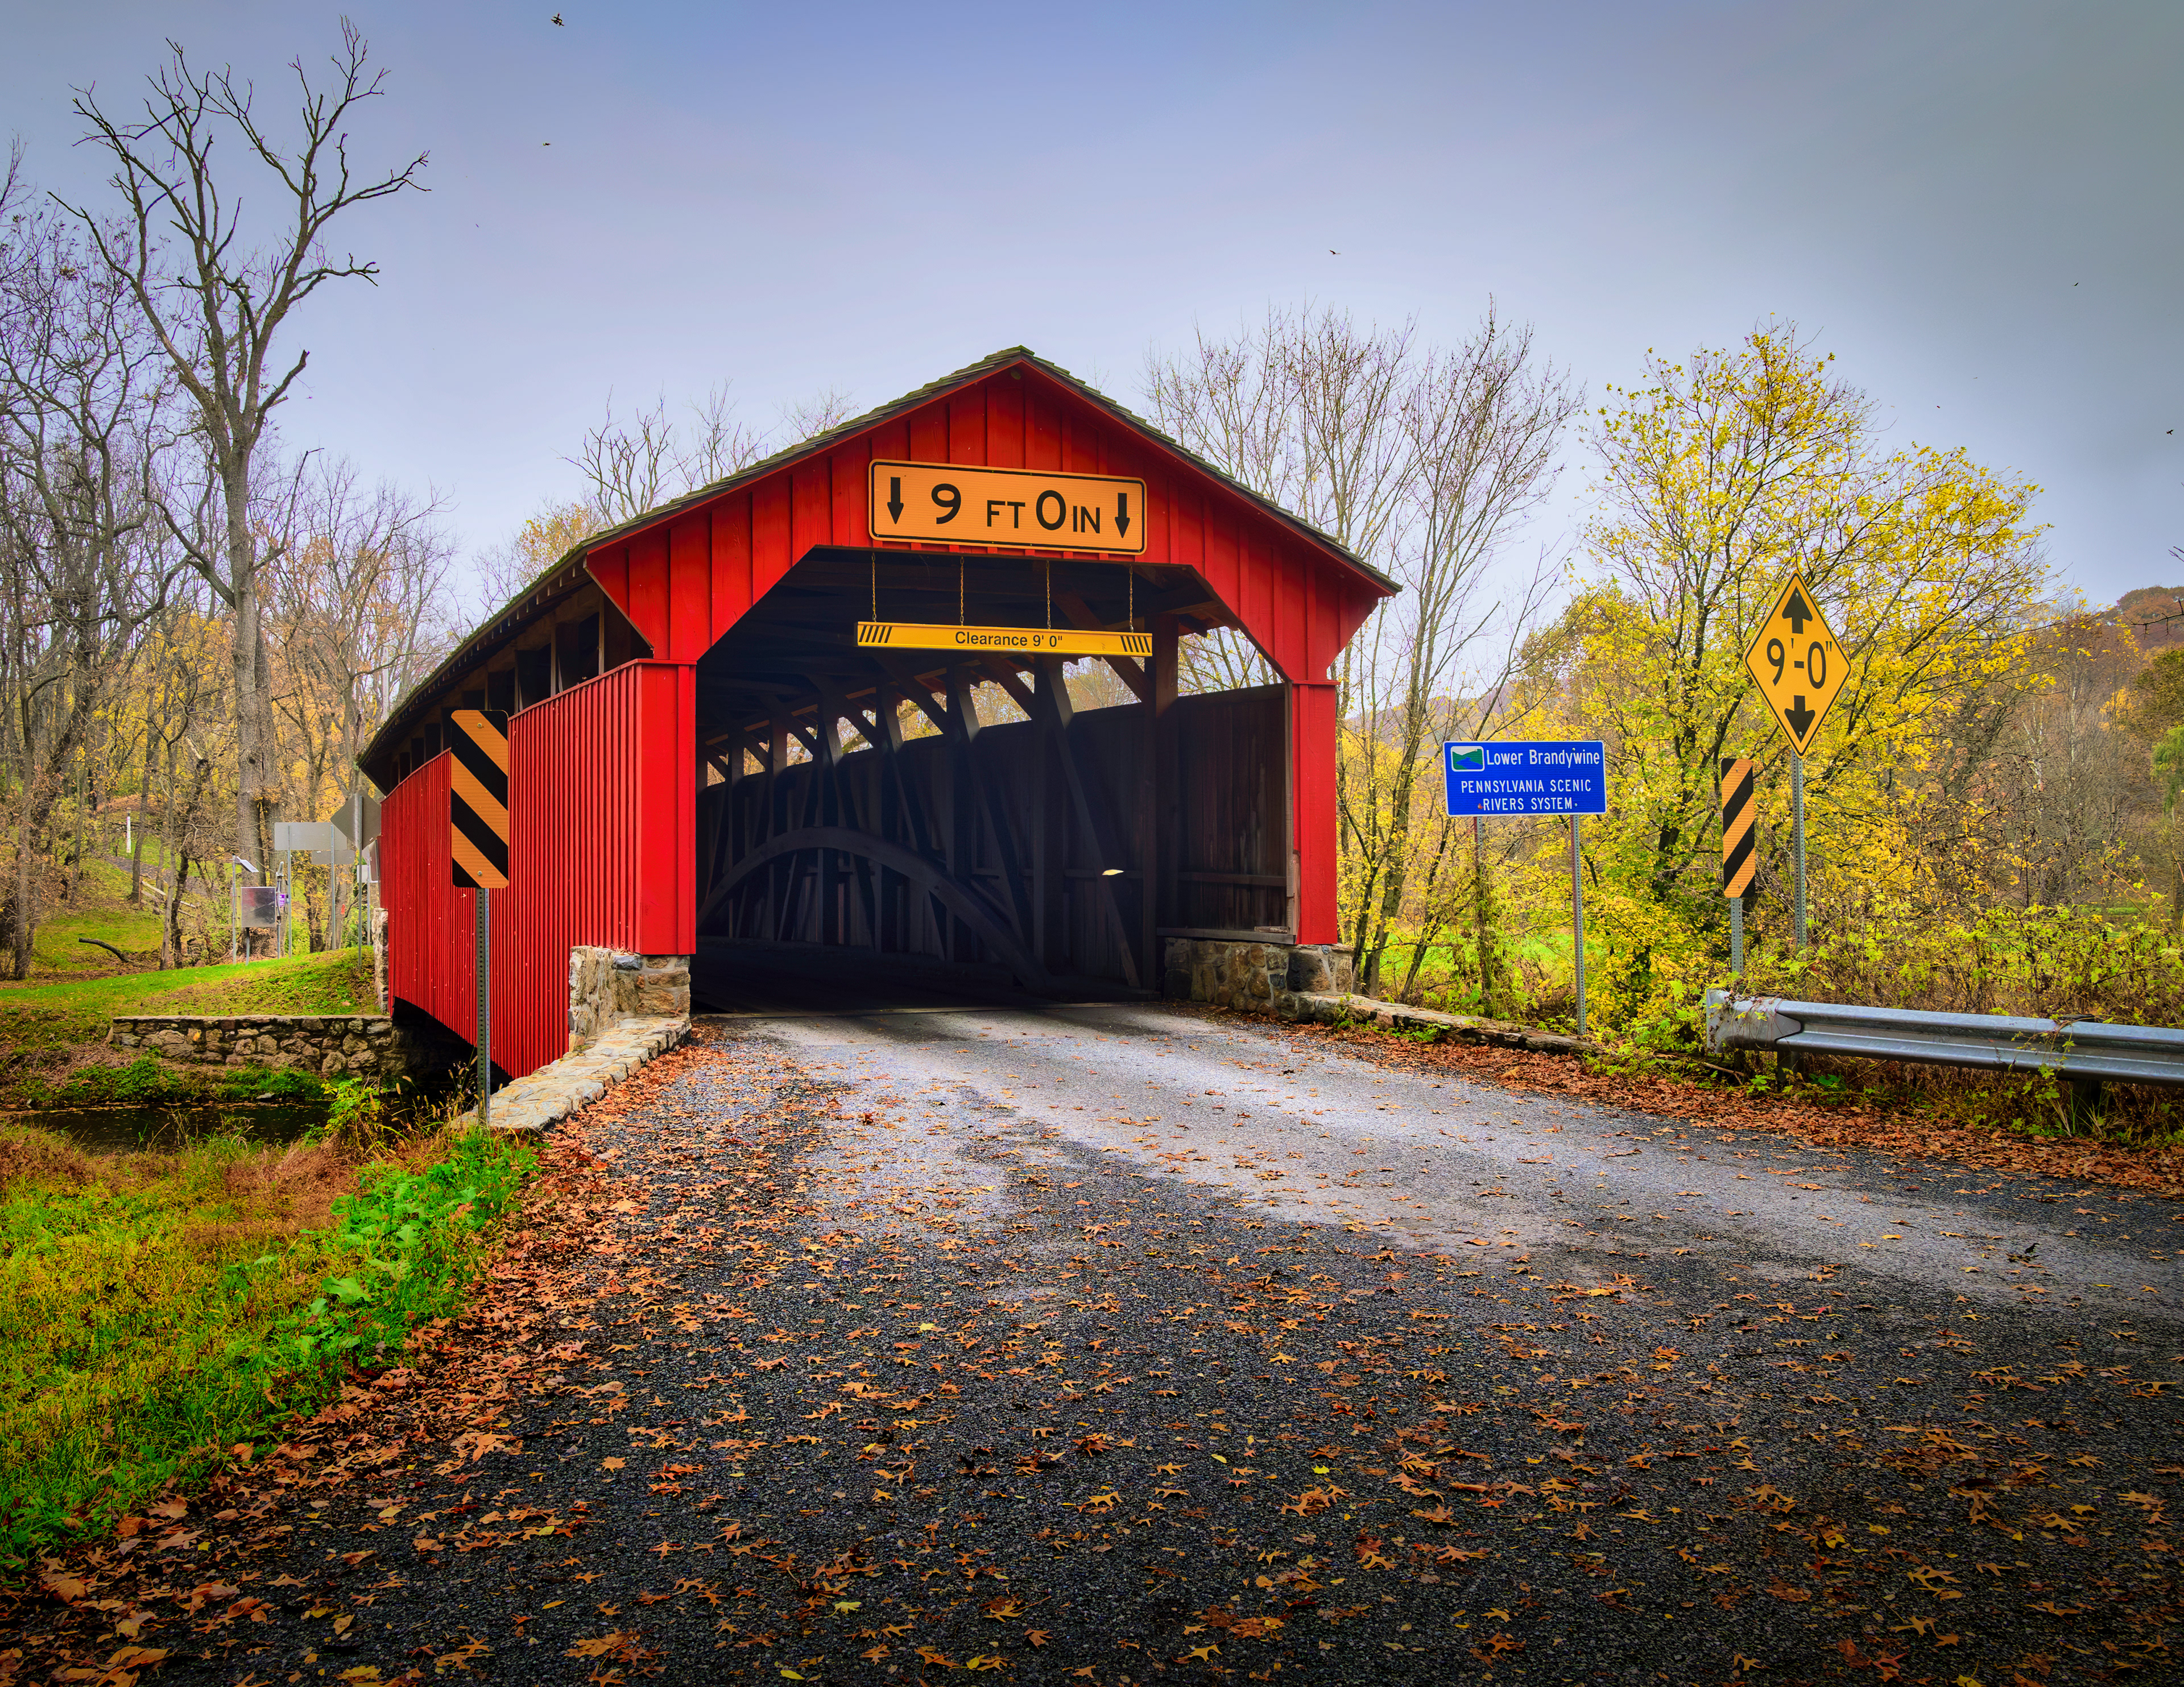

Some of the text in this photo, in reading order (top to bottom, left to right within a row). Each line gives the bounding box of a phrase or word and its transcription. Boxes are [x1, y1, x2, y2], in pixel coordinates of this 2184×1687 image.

[931, 483, 961, 524] 9
[987, 499, 1025, 529] FT
[1073, 505, 1101, 534] IN
[955, 631, 1062, 648] Clearance 9' 0"
[1486, 749, 1600, 768] Lower Brandywine
[1461, 779, 1591, 793] PENNSYLVANIA SCENIC
[1483, 797, 1573, 811] RIVERS SYSTEM
